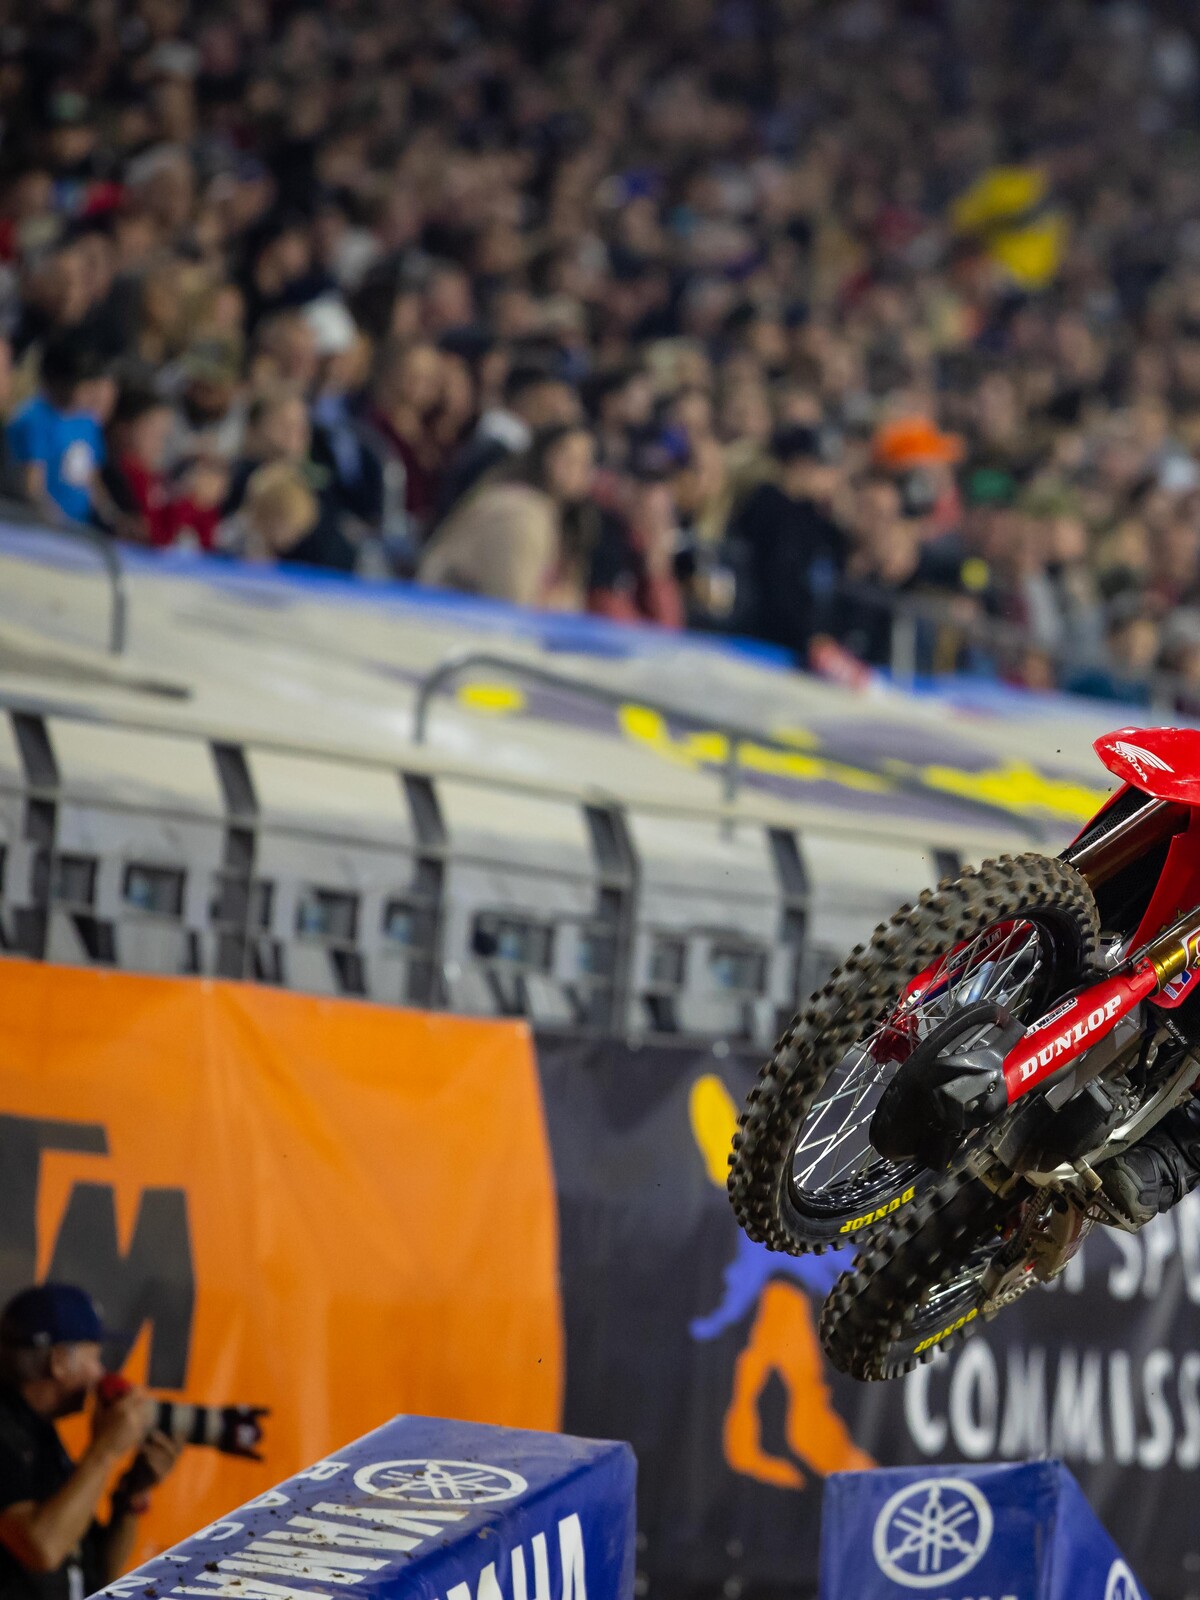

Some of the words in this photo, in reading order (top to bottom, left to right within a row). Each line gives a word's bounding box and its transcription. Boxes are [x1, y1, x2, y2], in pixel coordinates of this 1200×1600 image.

[1104, 744, 1148, 783] HONDA
[1020, 994, 1122, 1082] DUNLOP
[1166, 1019, 1180, 1036] Twin
[1178, 1035, 1188, 1045] Air
[839, 1186, 916, 1234] DUNLOP
[0, 1113, 197, 1391] TM
[913, 1307, 978, 1354] DUNLOP
